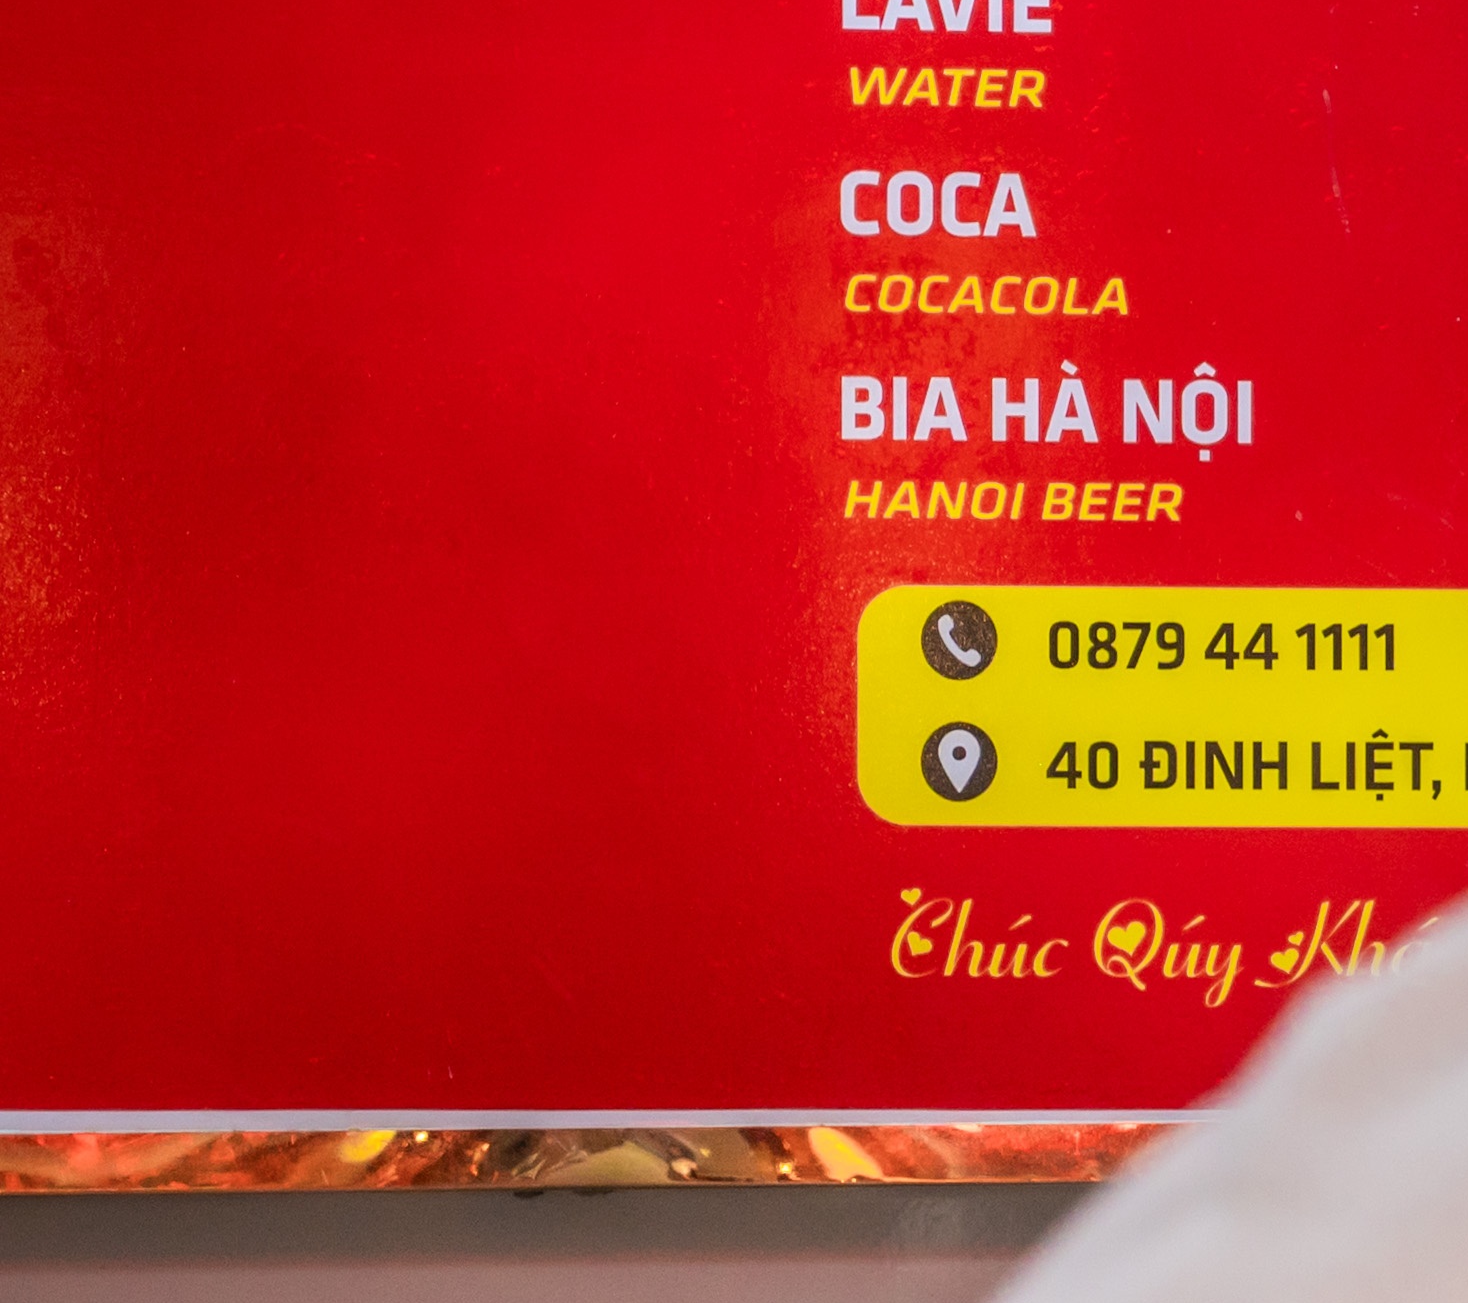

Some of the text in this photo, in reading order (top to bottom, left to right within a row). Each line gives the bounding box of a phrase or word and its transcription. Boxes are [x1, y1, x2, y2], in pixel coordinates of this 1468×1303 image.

[850, 67, 1045, 107] WATER
[840, 170, 1036, 237] COCA
[845, 274, 1128, 315] COCACOLA
[841, 360, 1252, 461] BIA HÀ NỘI
[844, 480, 1182, 521] HANOI BEER
[1050, 622, 1393, 670] 0879 44 1111
[1047, 742, 1118, 789] 40
[1140, 742, 1287, 789] ĐINH
[1312, 730, 1440, 799] LIỆT,
[892, 888, 1068, 977] Chúc
[1094, 901, 1241, 1006] Qúy
